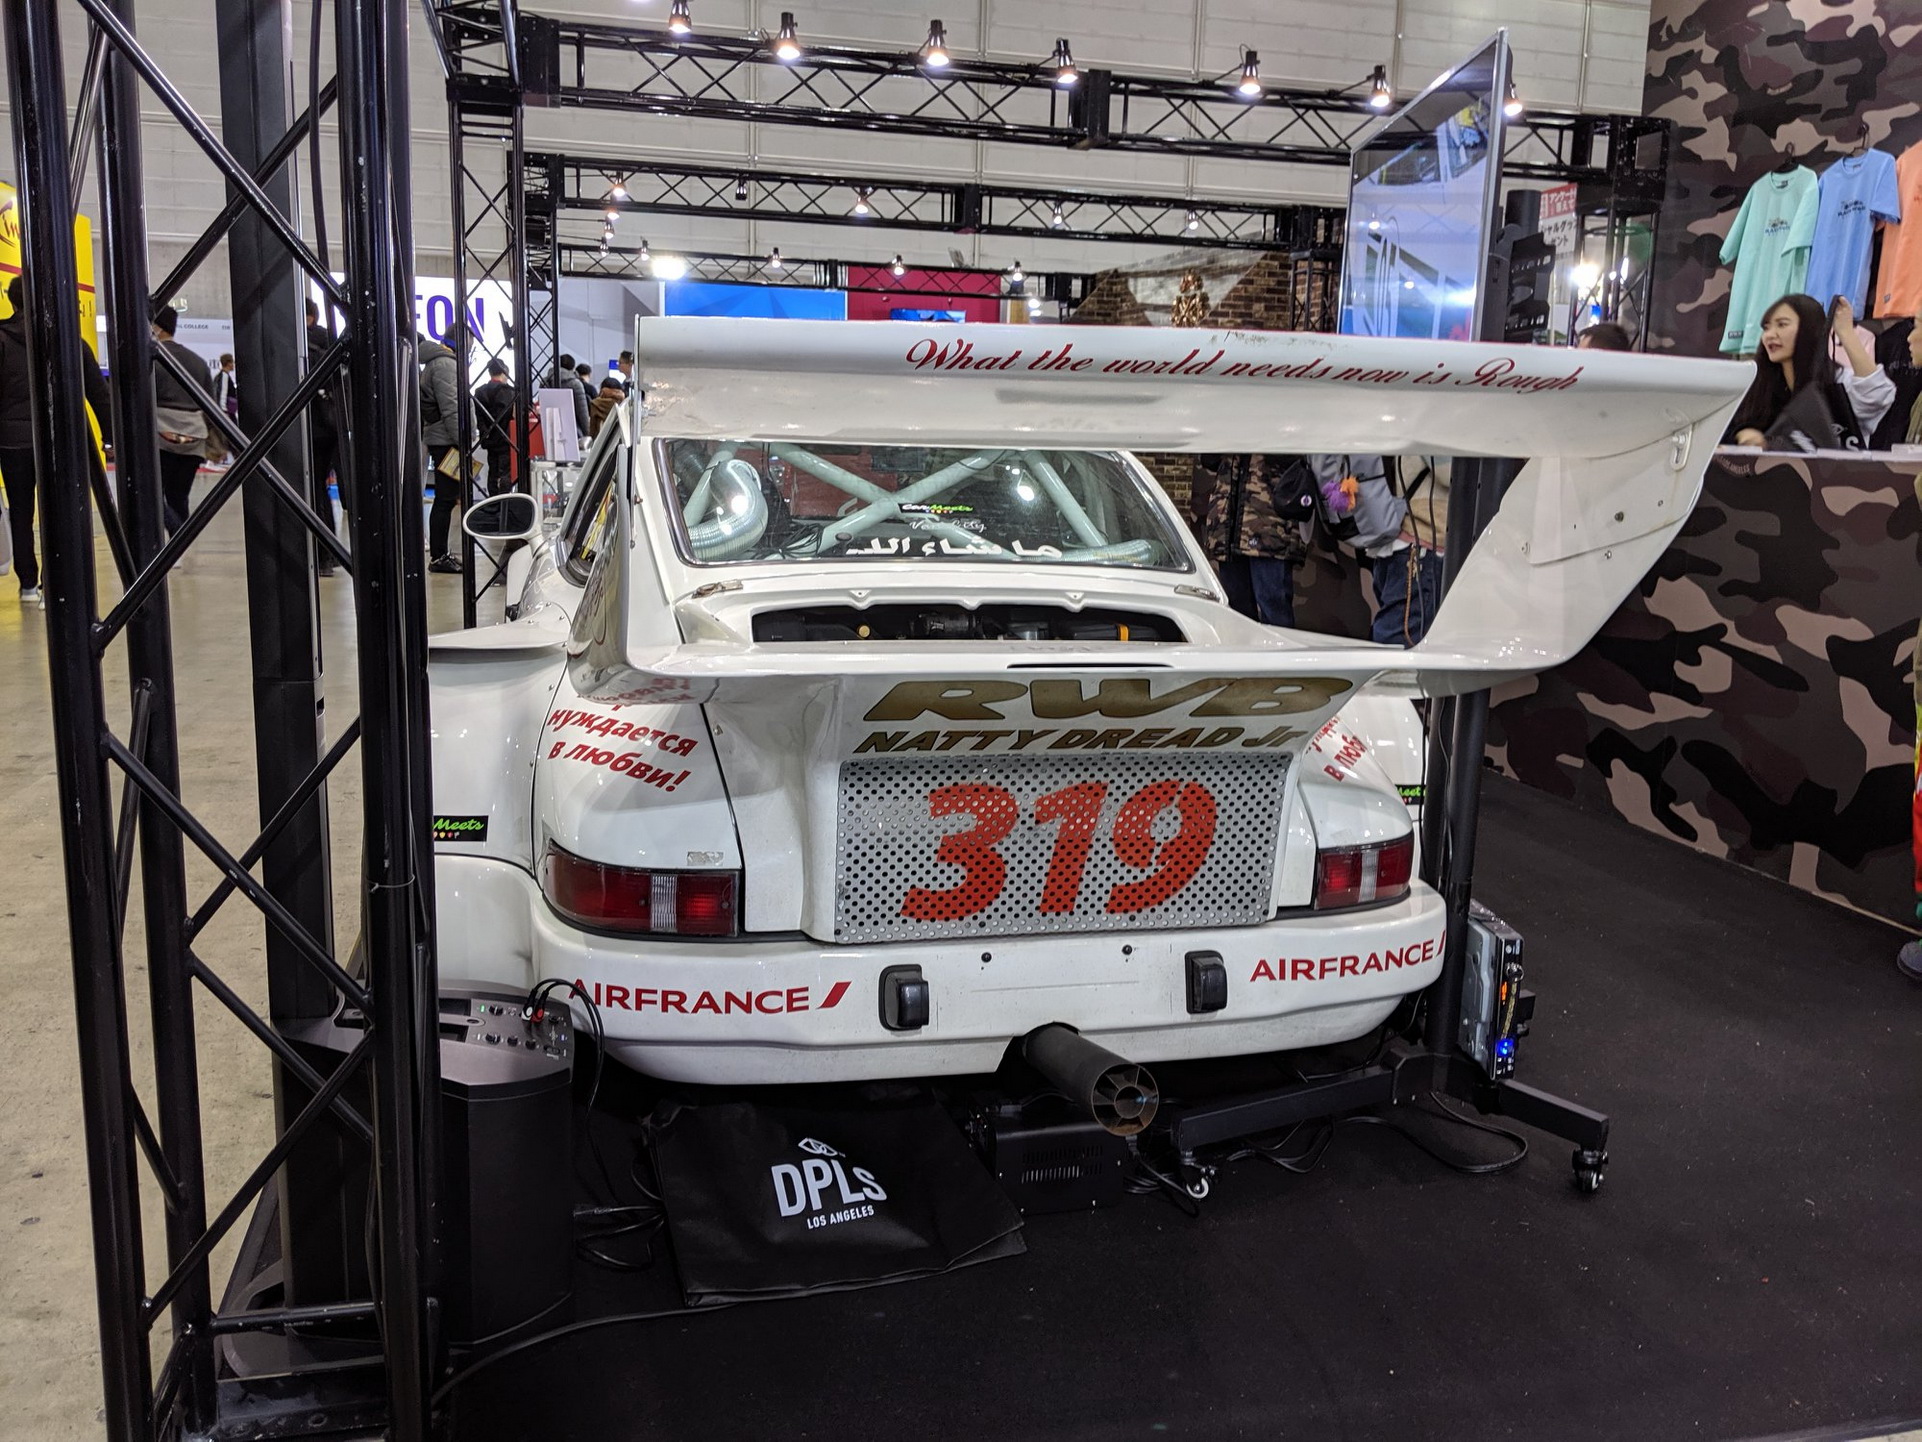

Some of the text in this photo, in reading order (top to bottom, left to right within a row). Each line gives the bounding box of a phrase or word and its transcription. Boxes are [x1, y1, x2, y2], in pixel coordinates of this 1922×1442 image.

[905, 338, 1585, 394] What the world needs now is Rough
[862, 677, 1354, 721] RWB
[546, 708, 699, 758] нуждается
[852, 728, 1061, 754] NATTY
[1046, 726, 1246, 750] DREAD
[1240, 725, 1309, 749] Jr
[563, 743, 692, 792] любви!
[432, 817, 485, 830] Meets
[900, 781, 1218, 922] 319
[1249, 938, 1435, 982] AIRFRANCE
[568, 978, 810, 1015] AIRFRANCE
[807, 1204, 875, 1230] LOS ANGELES
